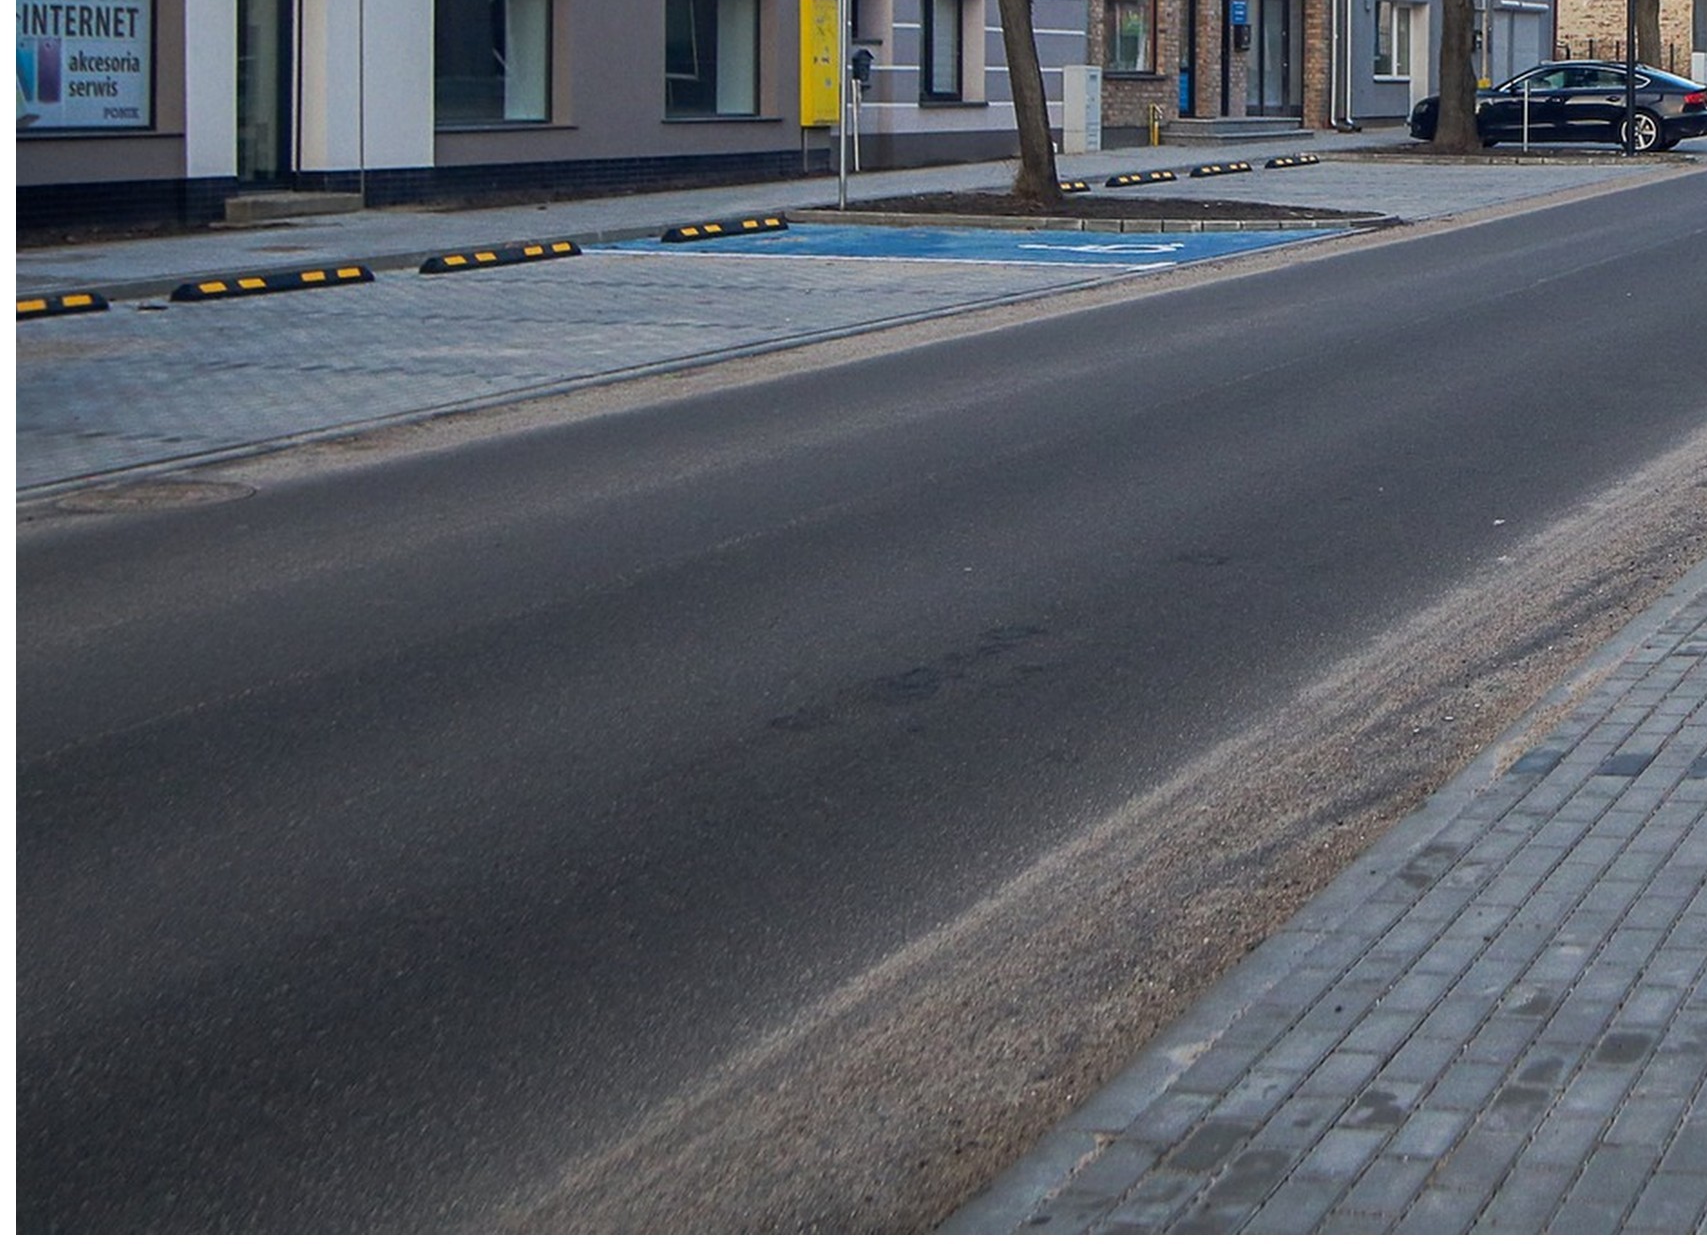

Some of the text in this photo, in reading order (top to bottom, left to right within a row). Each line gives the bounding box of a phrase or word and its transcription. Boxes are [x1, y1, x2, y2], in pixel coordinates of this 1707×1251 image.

[22, 3, 139, 38] INTERNET
[68, 50, 141, 73] akcesoria
[68, 76, 119, 97] serwis
